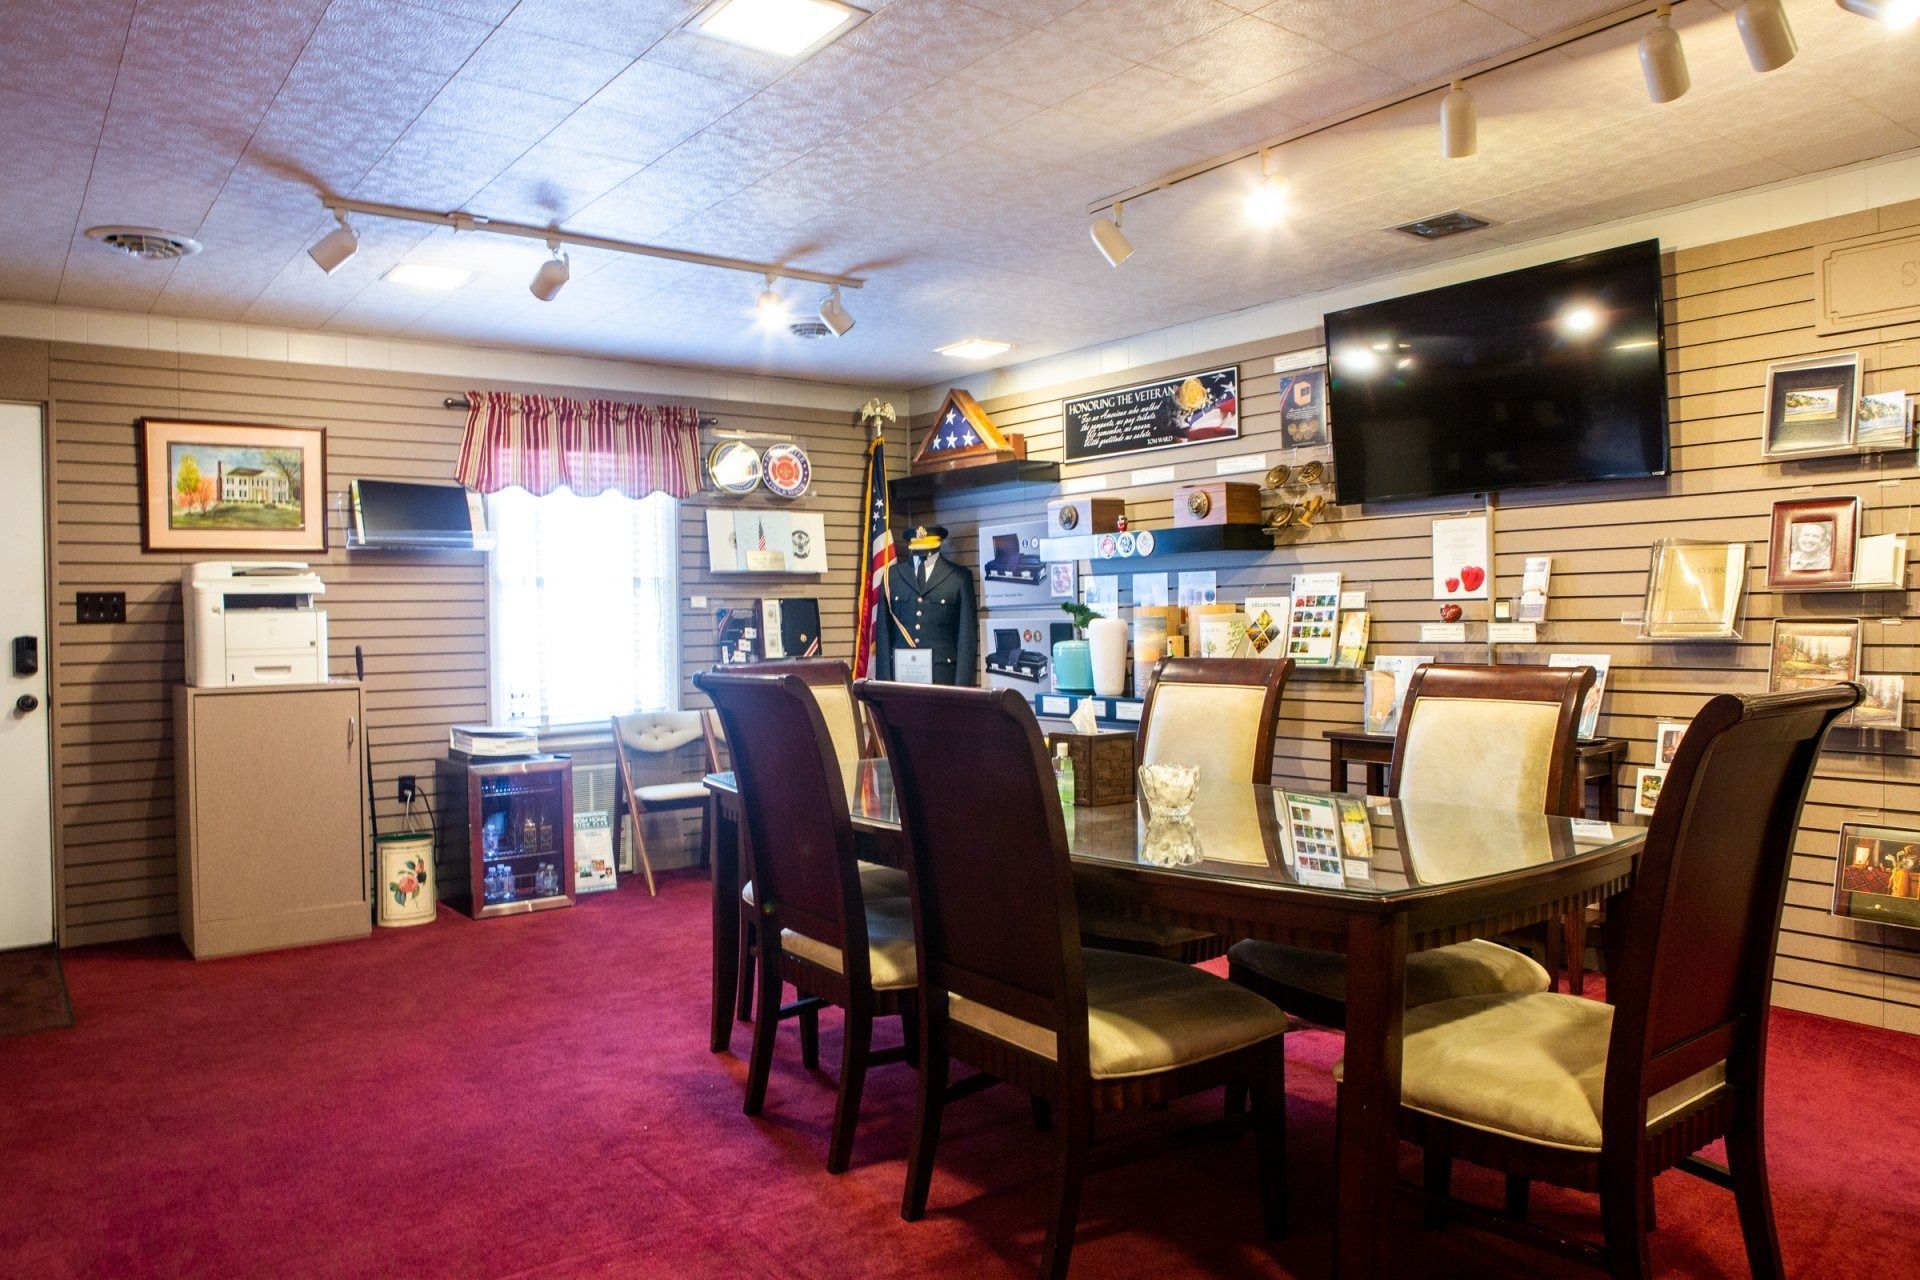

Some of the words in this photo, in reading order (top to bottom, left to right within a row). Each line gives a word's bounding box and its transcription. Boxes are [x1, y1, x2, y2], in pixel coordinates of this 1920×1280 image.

[1069, 397, 1115, 415] HONORING
[1116, 393, 1133, 405] THE
[1134, 385, 1176, 402] VETERAN
[1100, 409, 1127, 420] American
